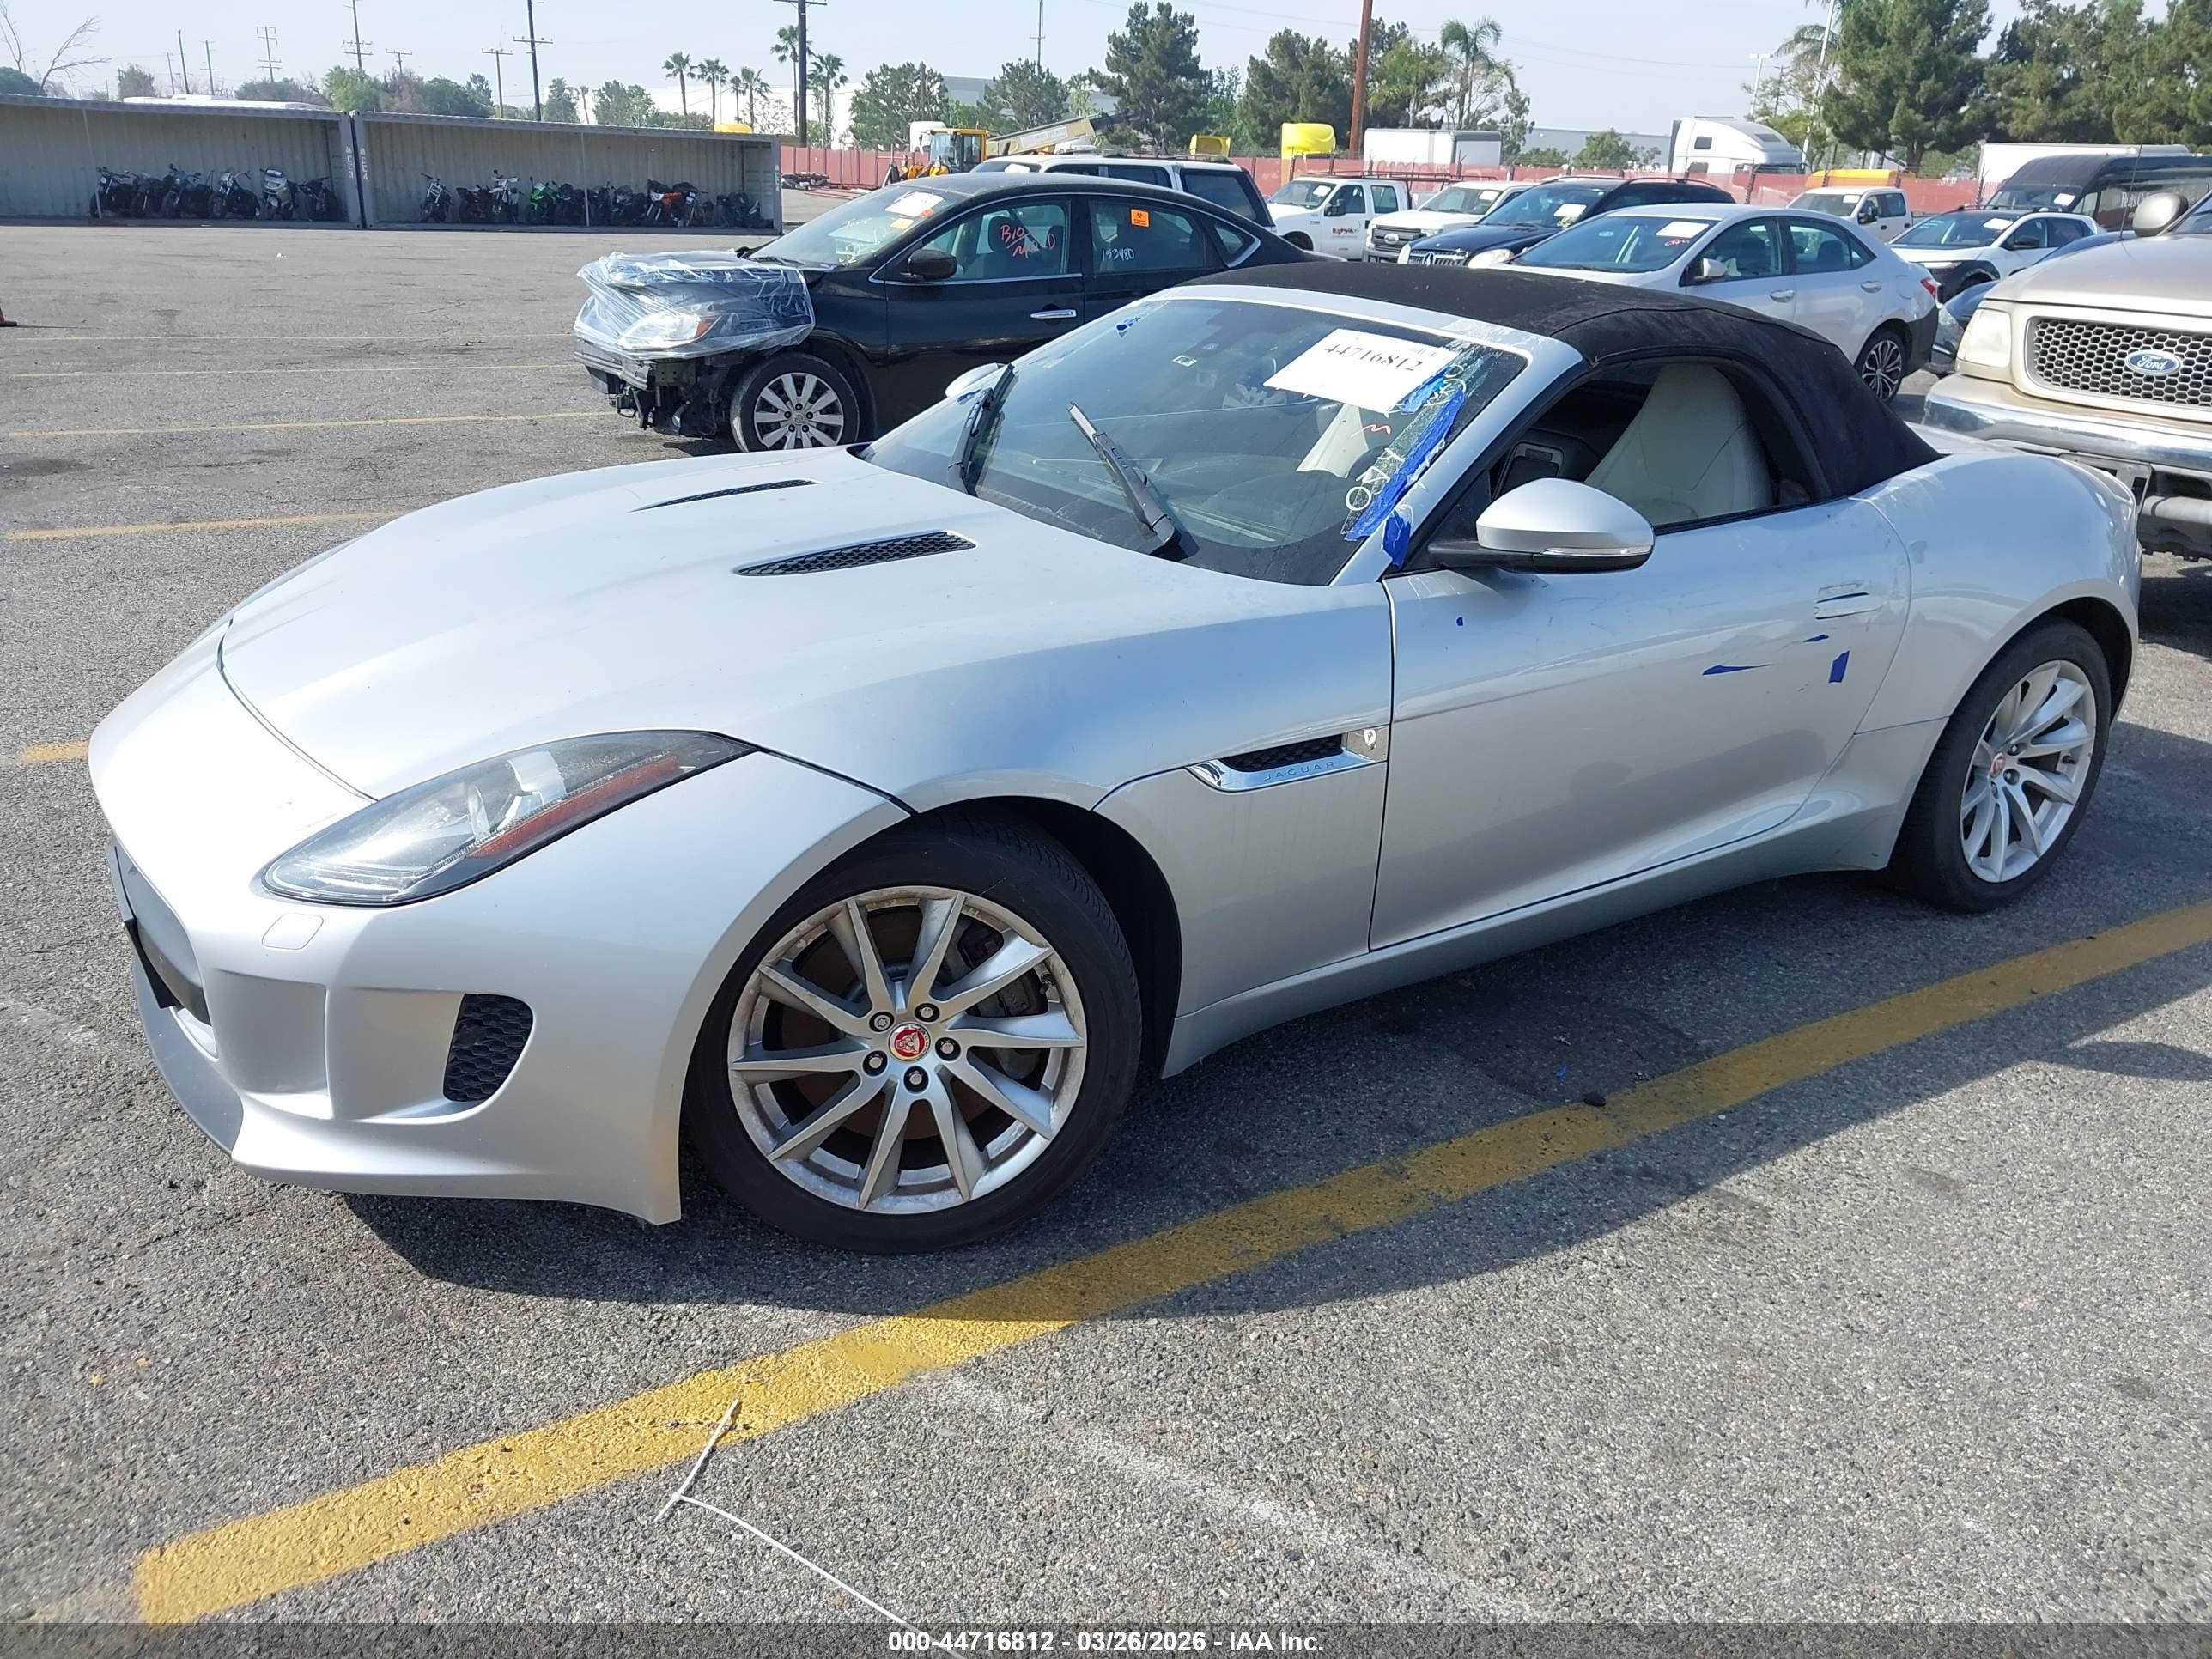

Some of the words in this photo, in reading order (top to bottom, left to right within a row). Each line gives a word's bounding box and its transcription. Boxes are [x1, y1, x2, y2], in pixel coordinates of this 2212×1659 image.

[1325, 343, 1423, 371] 44716812
[2136, 355, 2168, 370] Ford
[1264, 761, 1334, 781] JAGUAR
